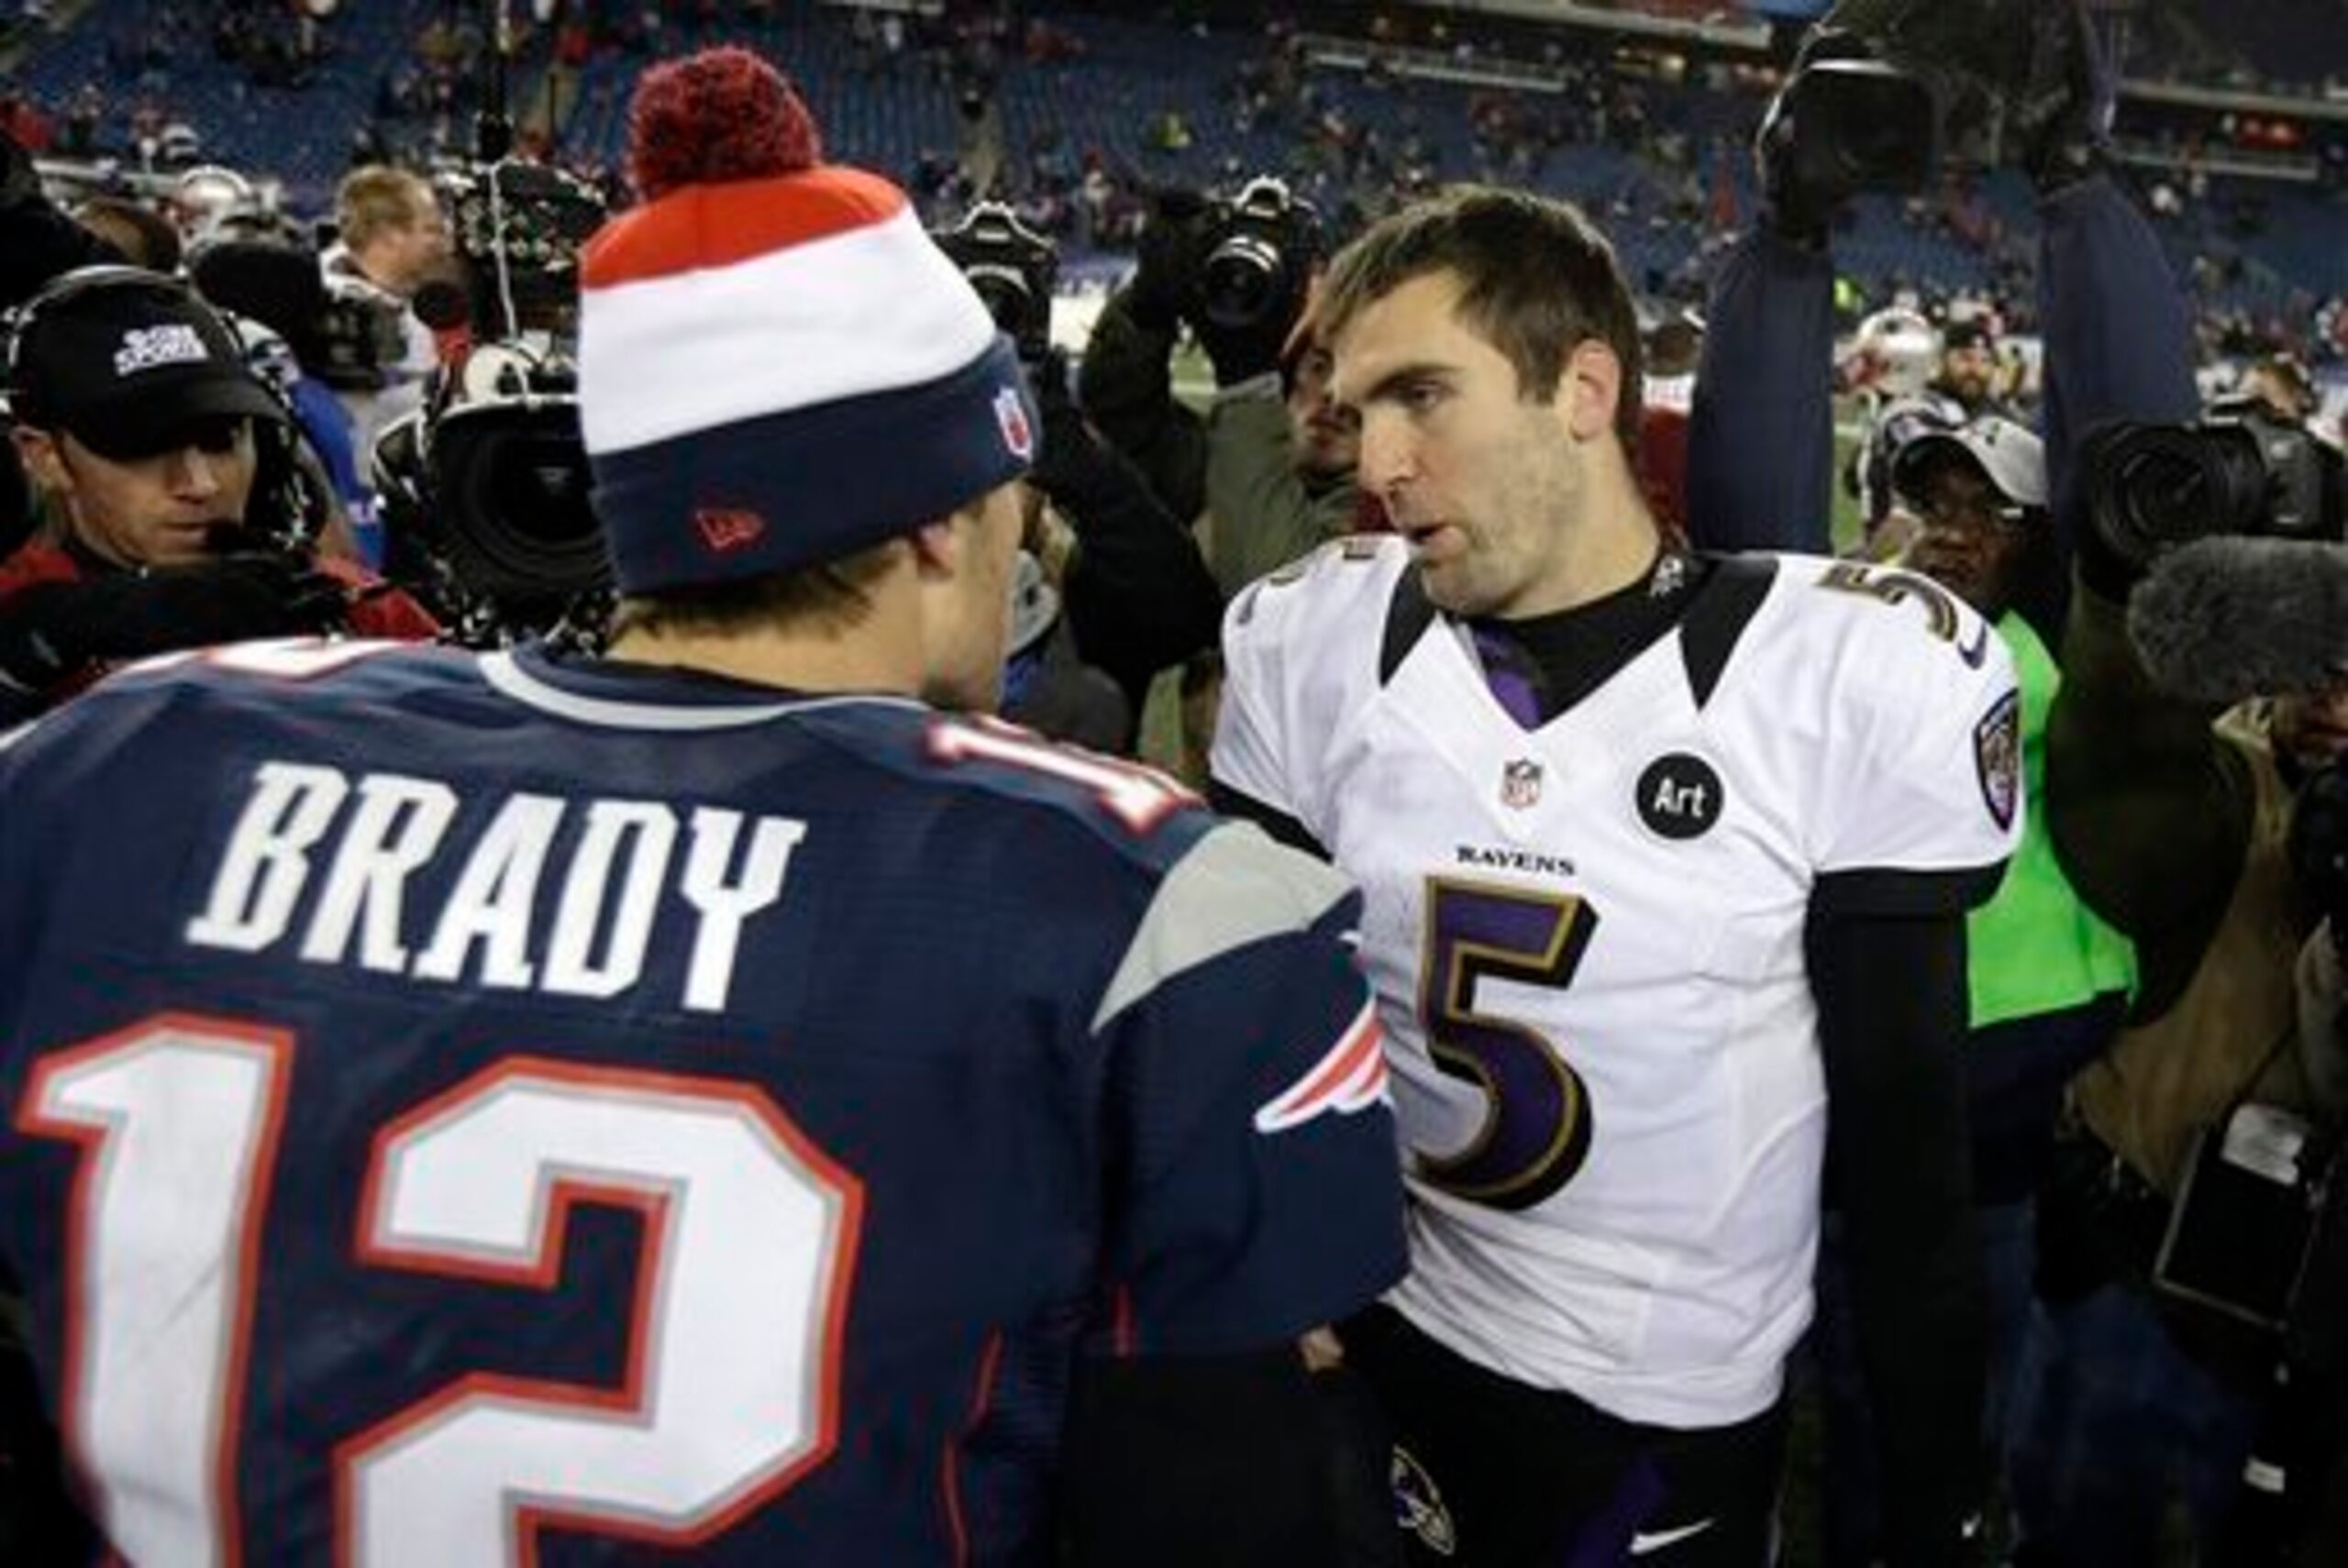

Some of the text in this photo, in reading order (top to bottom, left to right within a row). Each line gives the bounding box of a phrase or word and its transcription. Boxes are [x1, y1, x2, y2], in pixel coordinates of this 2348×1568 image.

[186, 760, 807, 1014] BRADY
[1456, 845, 1577, 877] RAVENS
[1653, 776, 1707, 820] Art
[1415, 873, 1600, 1212] 5
[14, 1012, 866, 1568] 12
